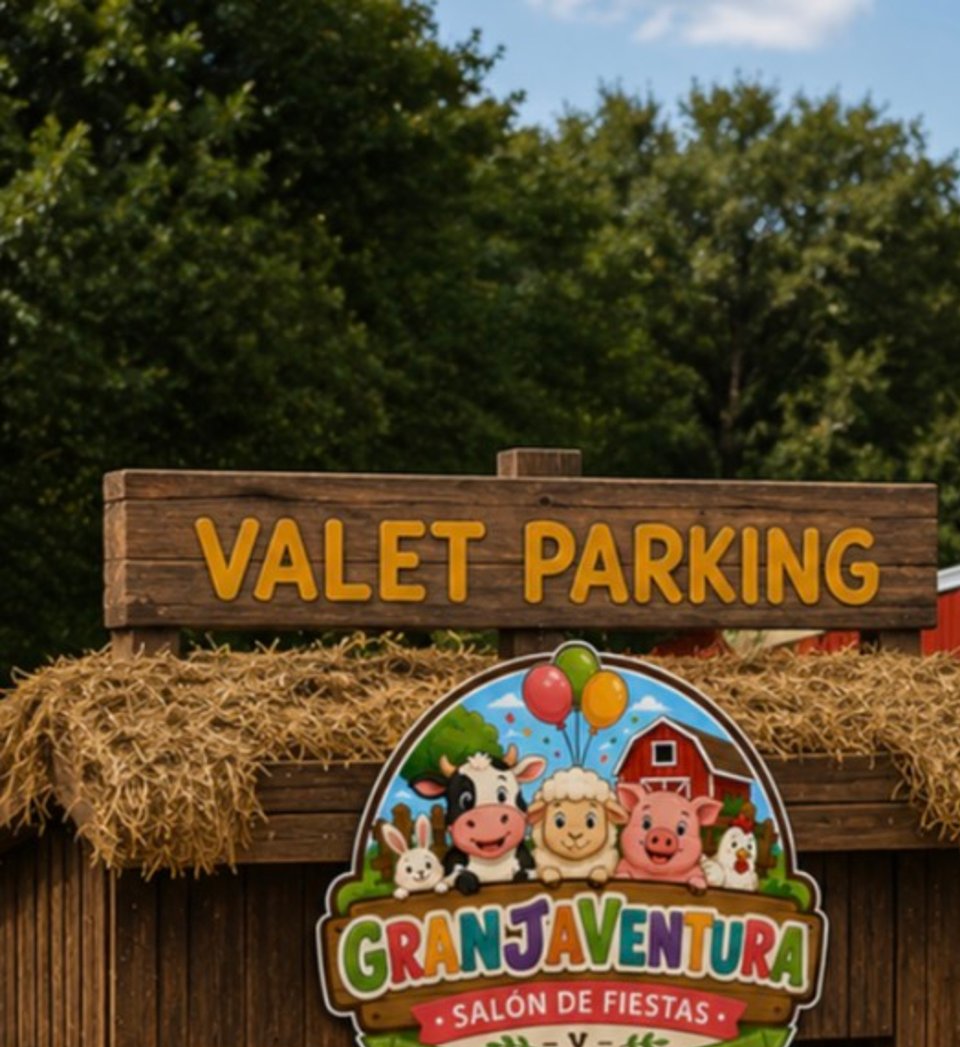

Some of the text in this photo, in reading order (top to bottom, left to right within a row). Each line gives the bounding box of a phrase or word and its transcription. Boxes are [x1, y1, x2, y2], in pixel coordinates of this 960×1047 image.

[195, 516, 881, 606] VALET PARKING
[343, 897, 807, 994] GRANJAVENTURA
[452, 989, 710, 1029] SALÓN DE FIESTAS
